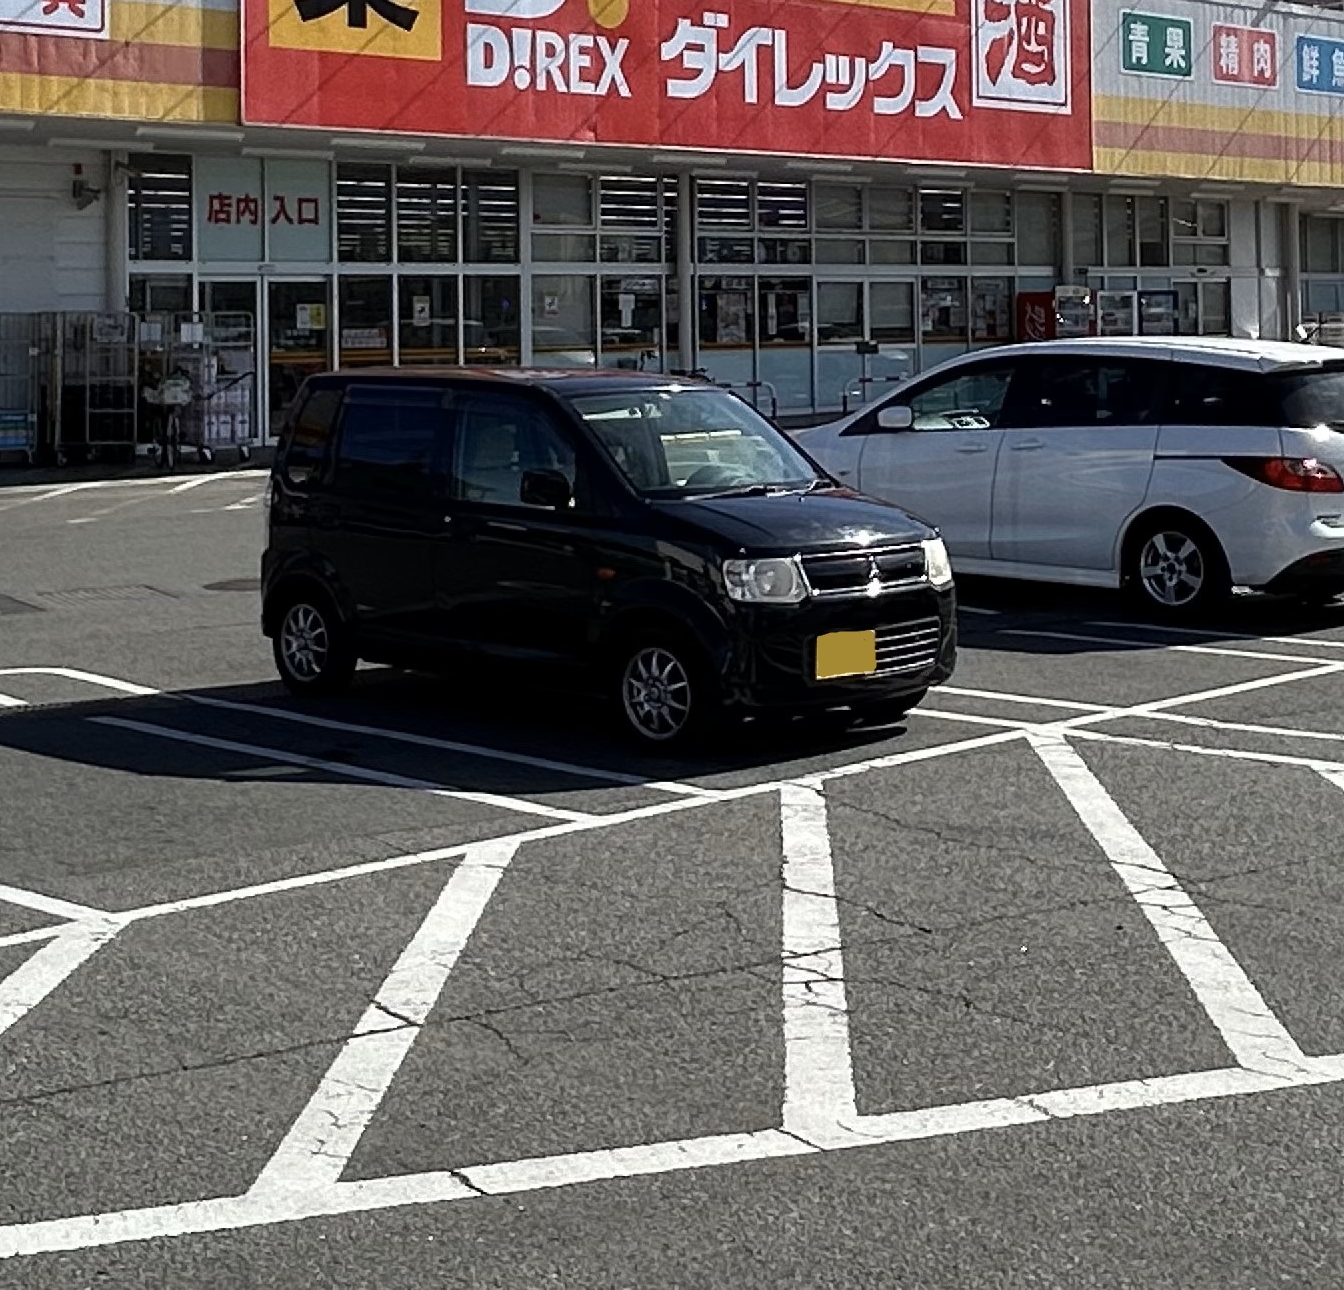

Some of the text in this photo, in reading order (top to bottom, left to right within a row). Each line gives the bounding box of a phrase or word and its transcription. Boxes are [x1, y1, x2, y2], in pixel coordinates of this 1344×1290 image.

[660, 11, 963, 120] ダイレックス
[1129, 22, 1185, 69] 青果
[1220, 33, 1271, 79] 精肉
